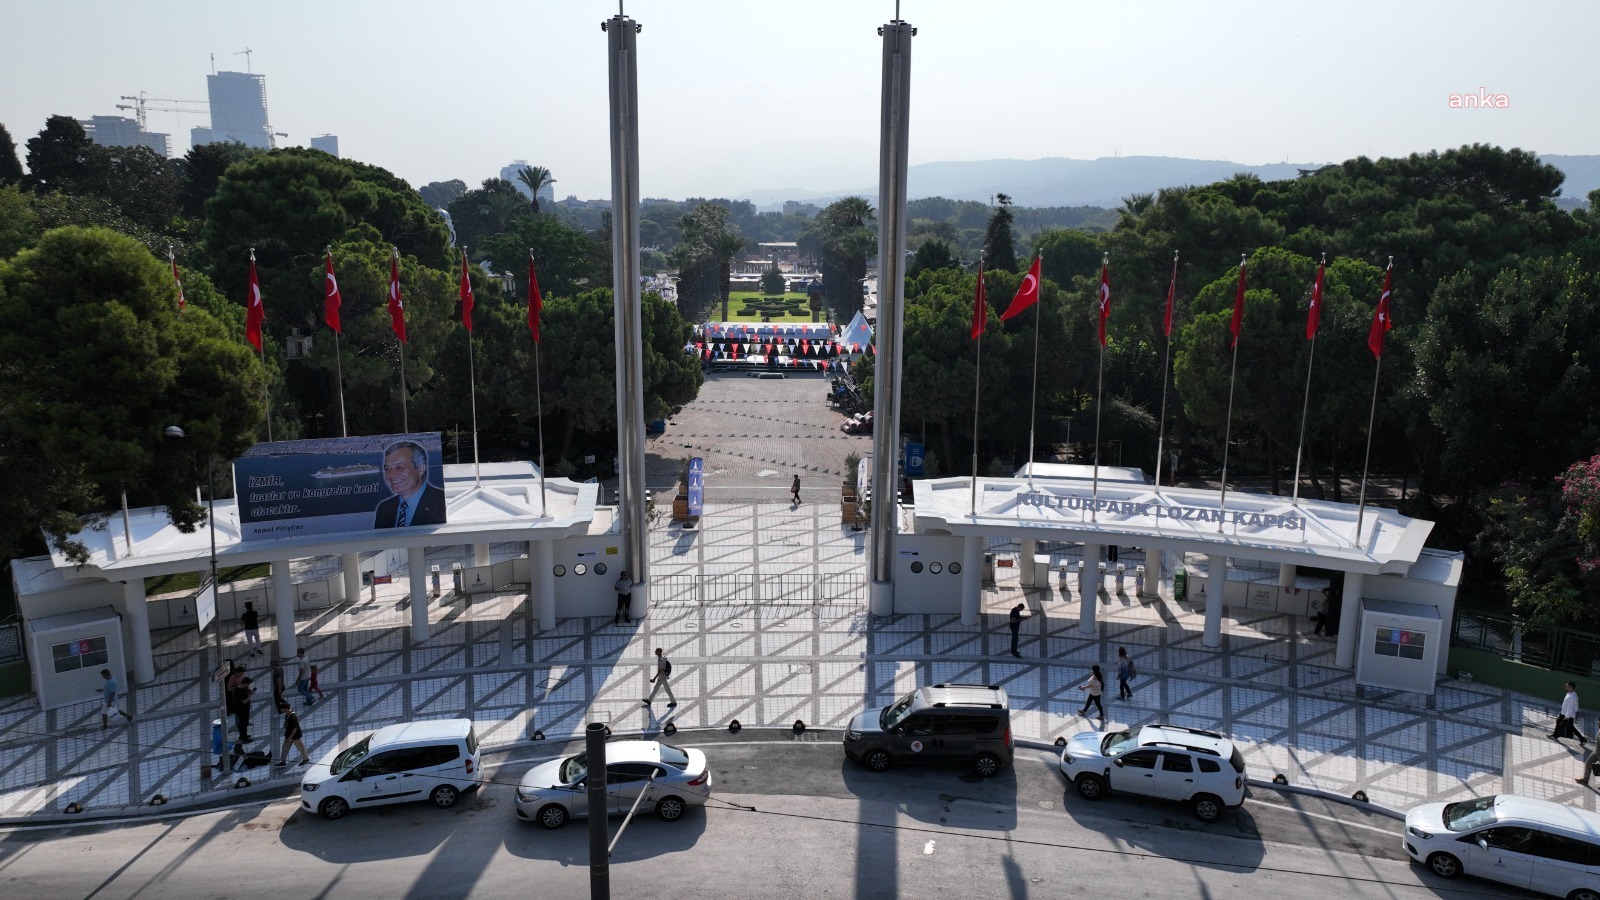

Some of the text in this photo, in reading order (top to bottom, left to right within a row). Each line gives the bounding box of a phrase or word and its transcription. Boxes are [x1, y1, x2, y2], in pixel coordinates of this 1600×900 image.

[288, 490, 301, 500] ve
[302, 485, 353, 499] kongreler
[353, 482, 380, 495] kenti
[1015, 491, 1307, 531] KÜLTÜRPARK LOZAN KAPISI
